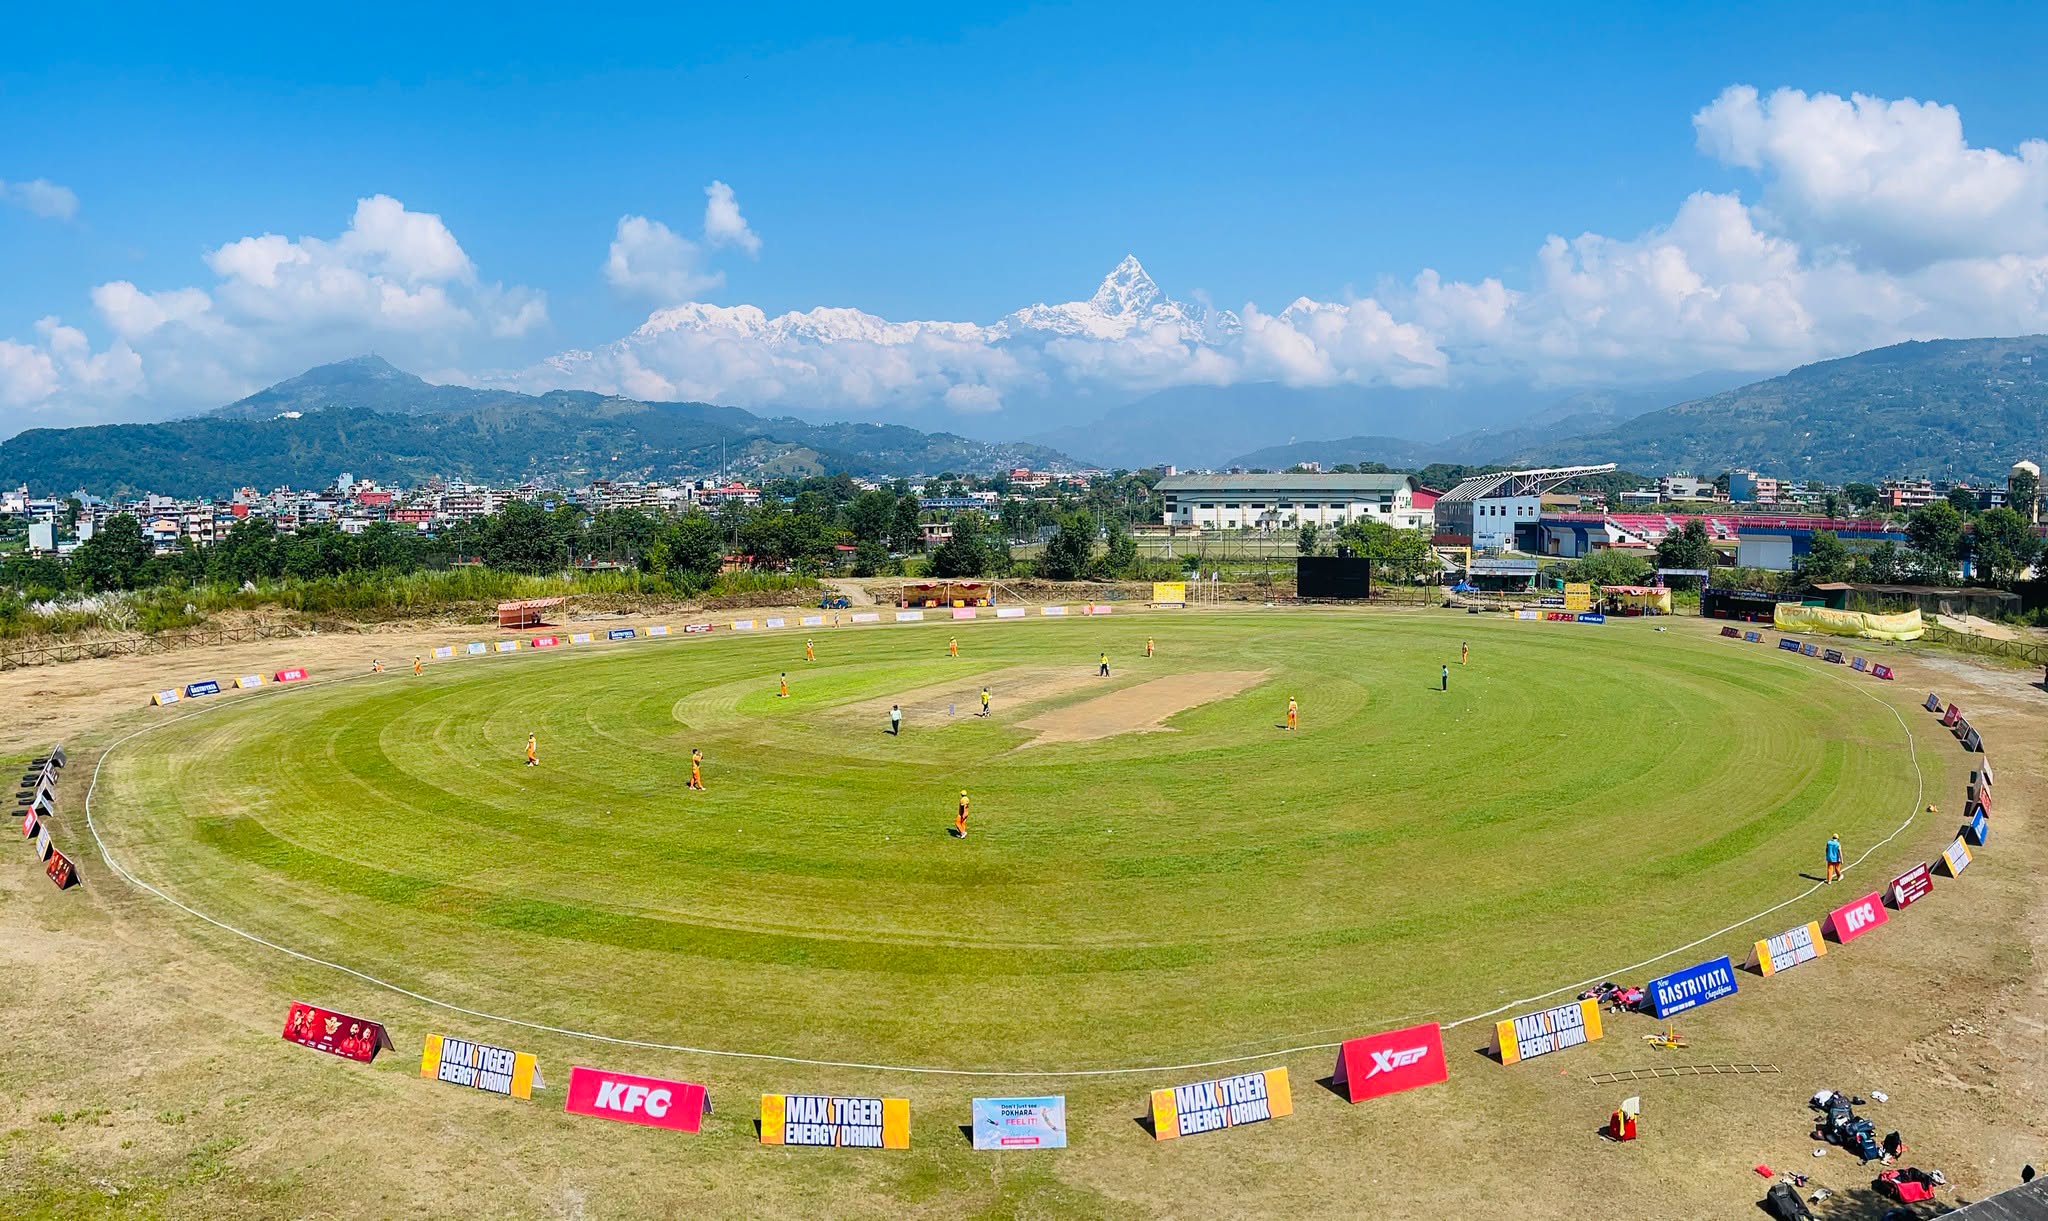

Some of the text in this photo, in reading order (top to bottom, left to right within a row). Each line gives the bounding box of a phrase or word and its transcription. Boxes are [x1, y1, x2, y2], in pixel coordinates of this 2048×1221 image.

[285, 670, 301, 680] KFC
[1844, 902, 1875, 932] KFC
[1767, 933, 1789, 958] MAX
[1658, 968, 1729, 1005] RASTRIYATA
[1515, 1004, 1584, 1041] MAX TIGER
[442, 1039, 515, 1075] MAX TIGER
[1519, 1025, 1586, 1059] ENERGY DRINK
[439, 1061, 513, 1095] ENERGY DRINK
[1365, 1046, 1428, 1079] XTEP
[594, 1081, 672, 1117] KFC
[1175, 1074, 1267, 1113] MAX TIGER
[786, 1097, 882, 1126] MAX TIGER
[1180, 1099, 1270, 1135] ENERGY DRINK
[786, 1123, 883, 1147] ENERGY DRINK
